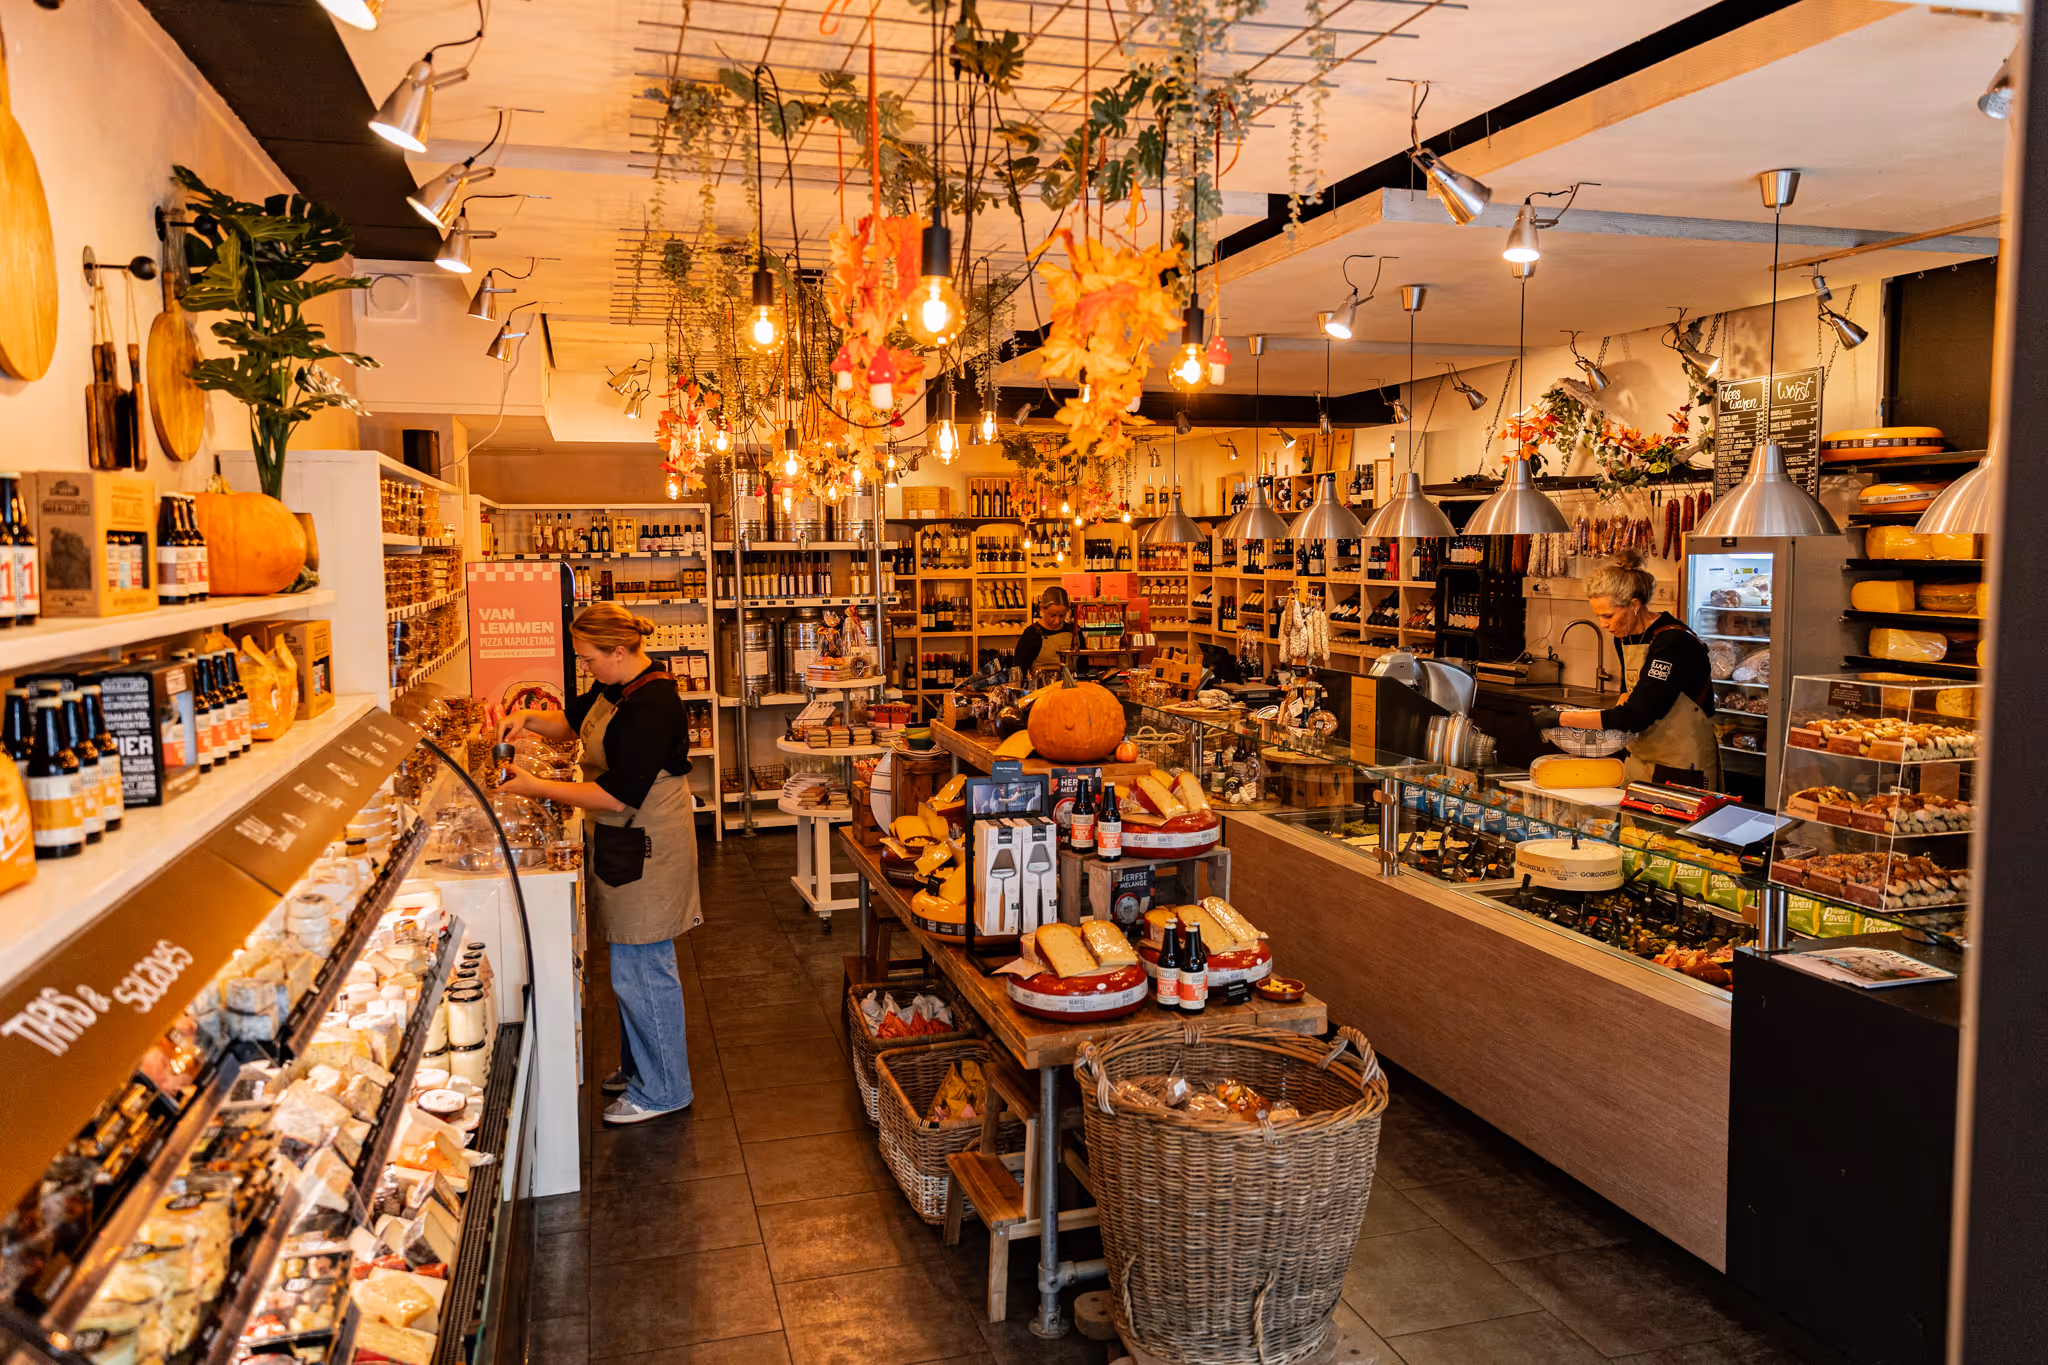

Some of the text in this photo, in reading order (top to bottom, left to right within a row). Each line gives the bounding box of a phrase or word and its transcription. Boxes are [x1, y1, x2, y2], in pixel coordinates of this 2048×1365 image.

[479, 608, 515, 620] VAN
[480, 622, 555, 635] LEMMEN
[480, 635, 555, 647] PIZZA NAPOLETANA
[1061, 778, 1093, 787] HERT
[1580, 869, 1618, 878] GORGONZOLA
[1120, 880, 1148, 889] MELANGE
[1823, 907, 1852, 922] Pavesi
